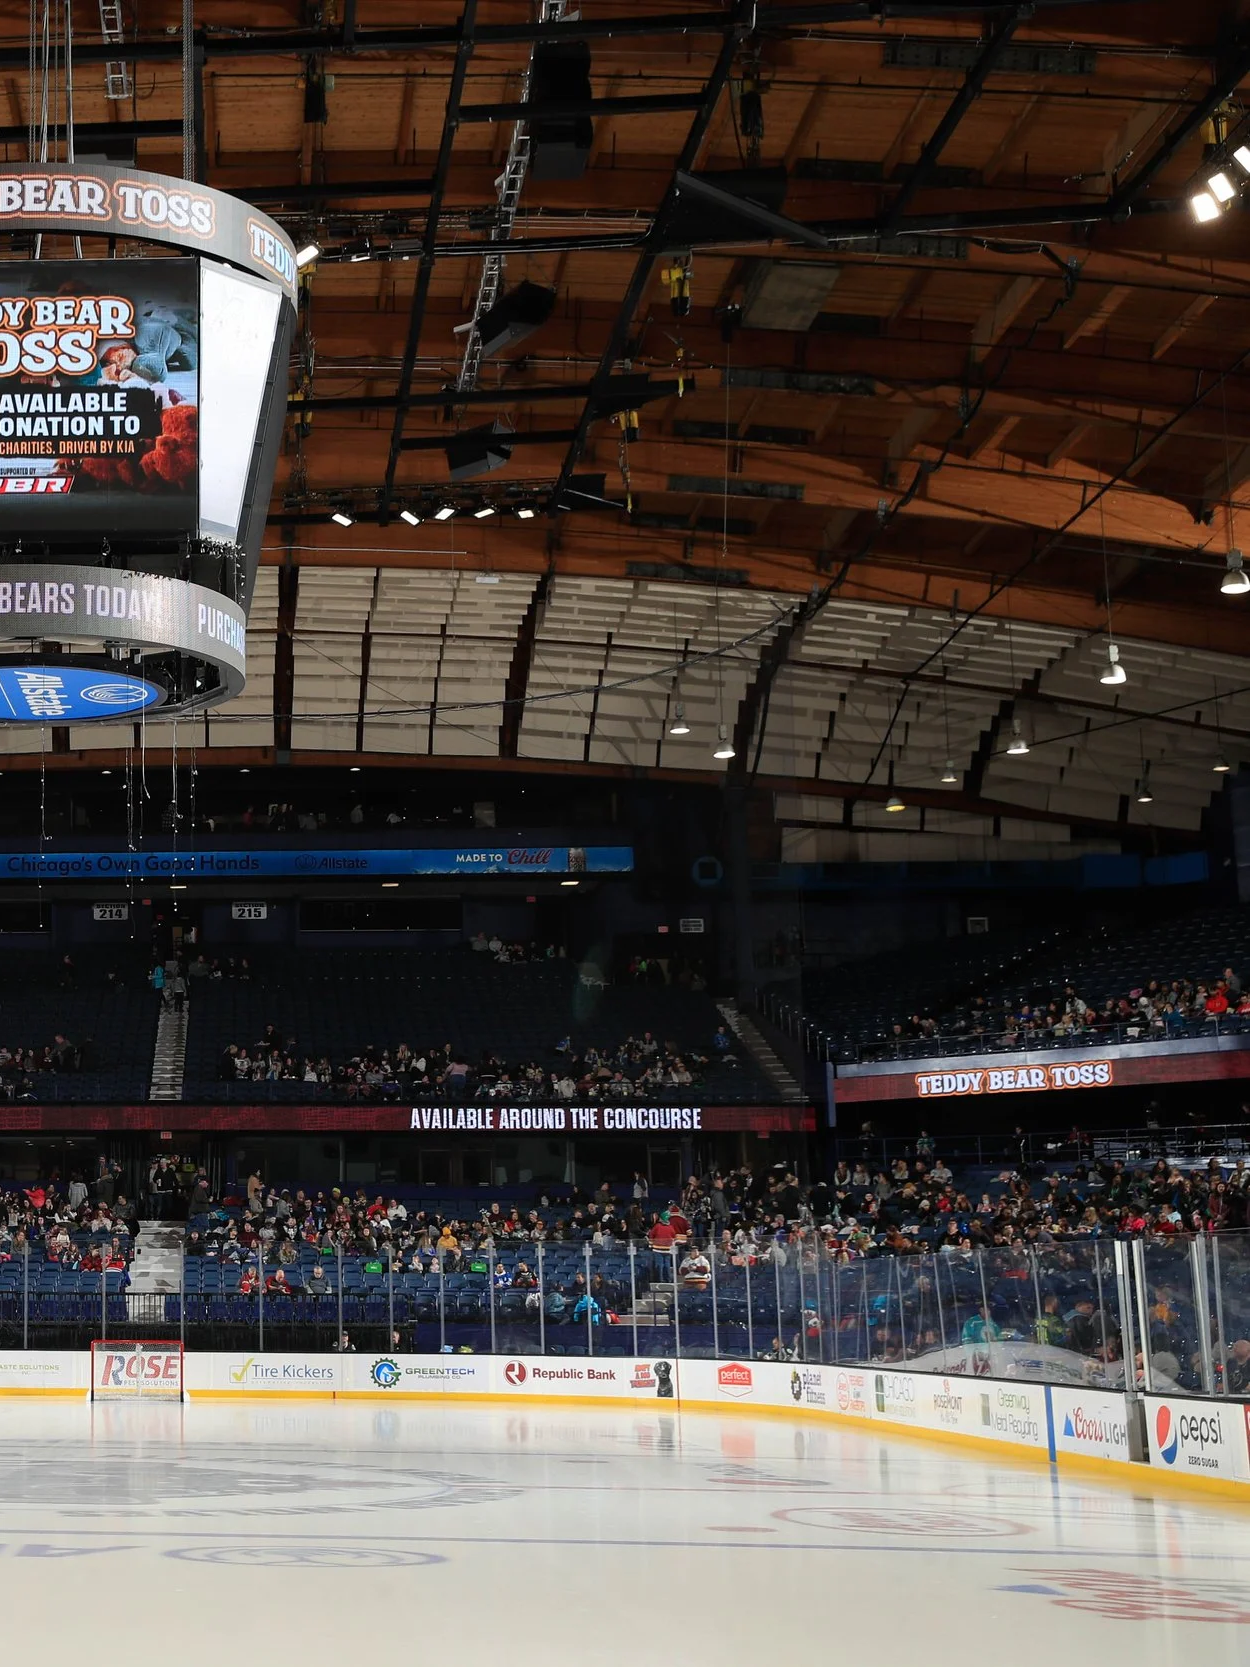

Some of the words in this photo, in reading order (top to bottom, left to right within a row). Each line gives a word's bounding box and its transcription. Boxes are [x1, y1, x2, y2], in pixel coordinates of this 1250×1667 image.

[117, 184, 213, 235] TOSS
[33, 299, 132, 336] BEAR
[109, 415, 141, 436] TO
[59, 440, 98, 454] DRIVEN
[100, 440, 114, 454] BY
[116, 440, 135, 454] KIA
[0, 467, 28, 476] SUPPORTED
[29, 467, 36, 476] BY
[198, 603, 246, 658] PURCHA
[13, 670, 73, 717] Allstate
[6, 855, 93, 876] Chicago's
[97, 856, 140, 872] Own
[145, 855, 195, 871] Good
[200, 854, 260, 871] Hands
[318, 856, 368, 869] Allstate
[456, 853, 487, 863] MADE
[488, 853, 503, 862] TO
[507, 848, 553, 865] Chill
[99, 908, 123, 919] 214
[237, 907, 262, 918] 215
[917, 1071, 983, 1095] TEDDY
[987, 1068, 1047, 1091] BEAR
[1051, 1063, 1110, 1087] TOSS
[410, 1108, 494, 1129] AVAILABLE
[499, 1108, 566, 1129] AROUND
[569, 1108, 599, 1129] THE
[603, 1108, 702, 1129] CONCOURSE
[101, 1355, 184, 1386] ROSE
[252, 1364, 279, 1378] Tire
[283, 1364, 334, 1378] Kickers
[405, 1367, 476, 1375] GREENTECH
[532, 1367, 584, 1381] Republic
[587, 1368, 617, 1381] Bank
[720, 1368, 750, 1381] perfect
[1072, 1406, 1104, 1443] Coors
[1103, 1421, 1127, 1446] LIGH
[1179, 1411, 1223, 1451] pepsi
[1187, 1455, 1202, 1467] ZERO
[1201, 1456, 1220, 1469] SUGAR
